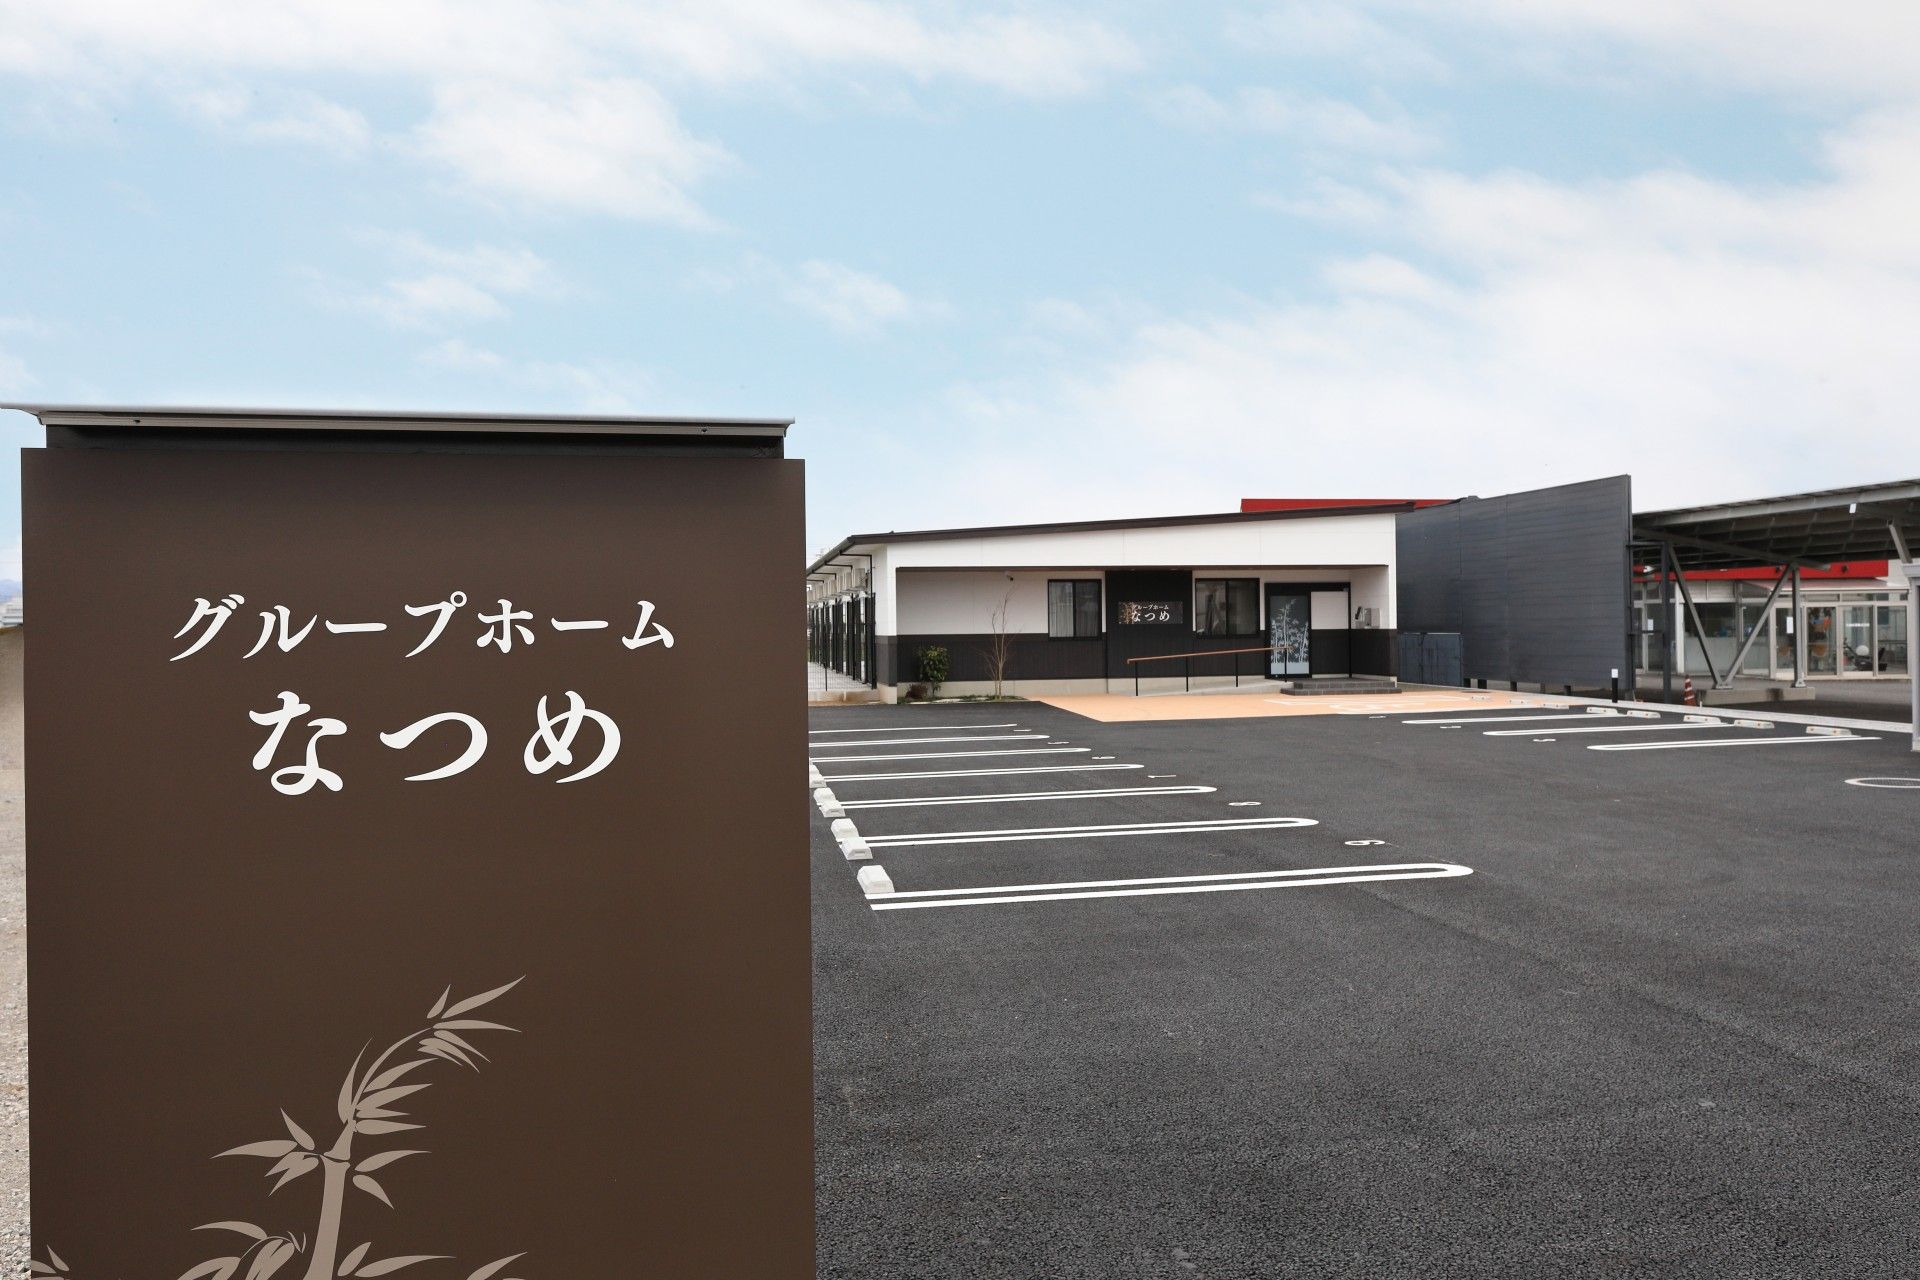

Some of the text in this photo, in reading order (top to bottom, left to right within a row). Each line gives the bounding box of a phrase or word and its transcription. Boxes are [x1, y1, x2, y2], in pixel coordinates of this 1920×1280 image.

[170, 590, 675, 662] グループホーム
[1131, 610, 1170, 622] なつめ
[248, 691, 622, 796] なつめ
